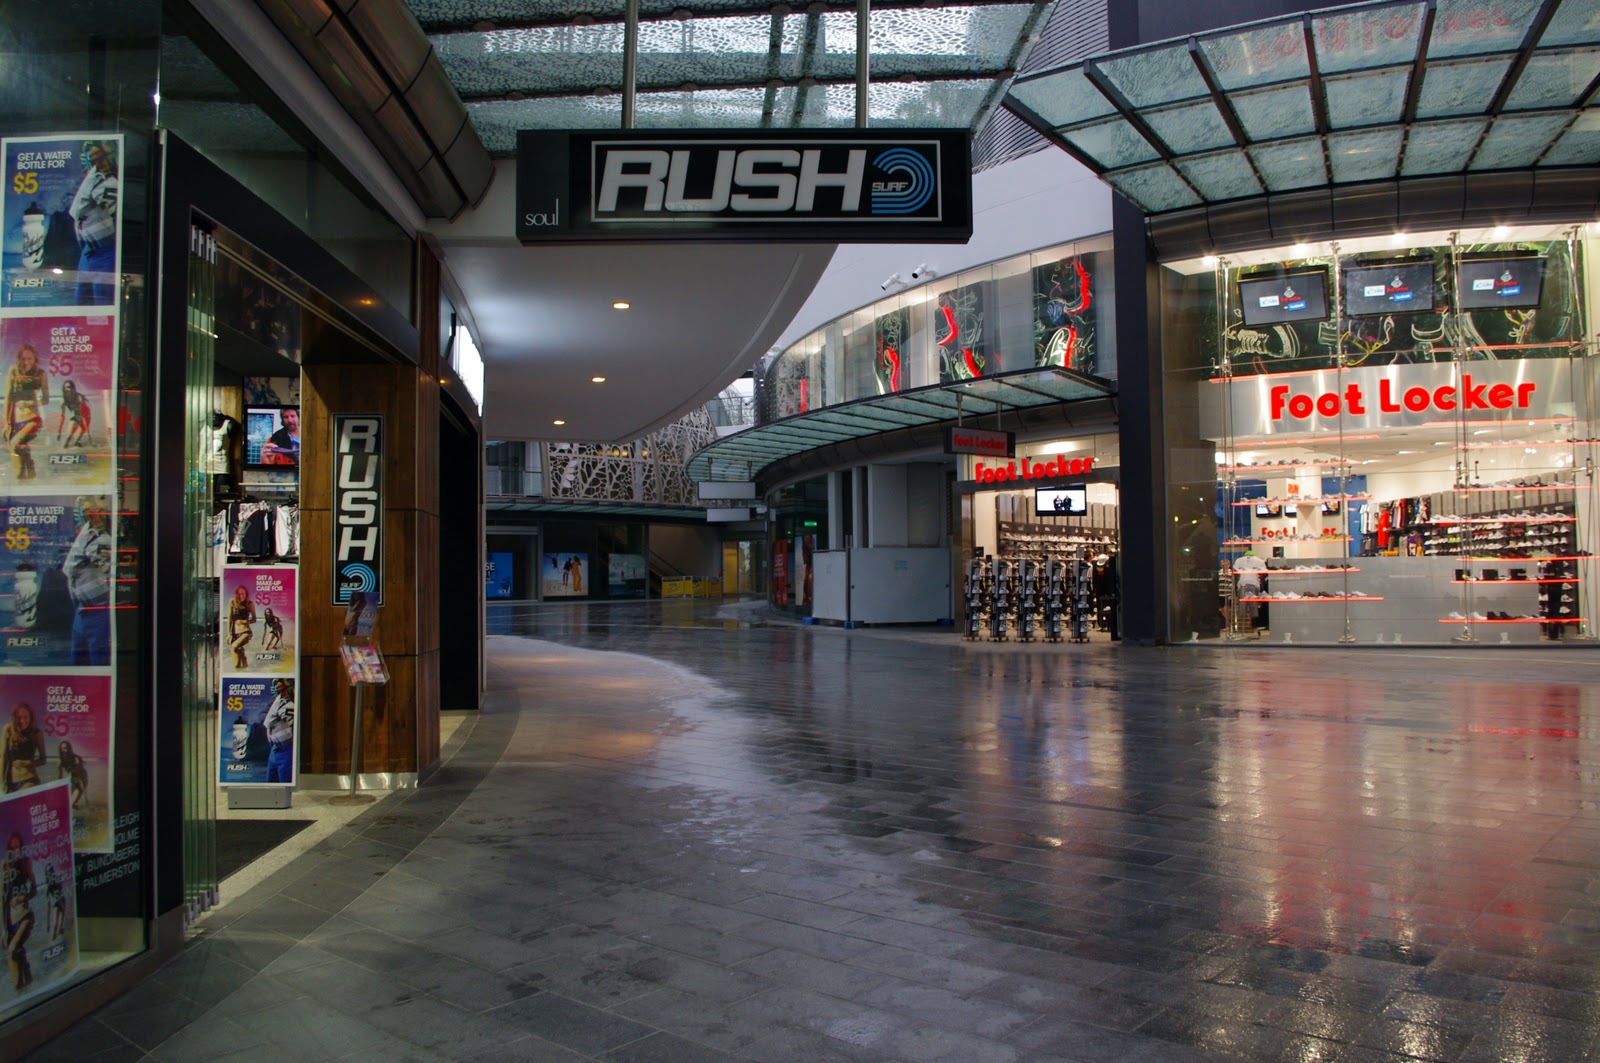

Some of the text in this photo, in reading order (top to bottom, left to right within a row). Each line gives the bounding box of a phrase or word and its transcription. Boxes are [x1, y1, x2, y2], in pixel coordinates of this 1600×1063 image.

[17, 151, 72, 162] GET A WATER
[17, 160, 66, 170] BOTTLE FOR
[13, 172, 38, 195] $5
[597, 149, 867, 212] RUSH
[872, 182, 909, 192] SURF
[525, 198, 559, 226] soul
[14, 279, 44, 288] RUSH
[51, 327, 77, 336] GET A
[51, 336, 90, 344] MAKE-UP
[51, 344, 93, 353] CASE FOR
[49, 354, 74, 376] $5
[1270, 374, 1536, 420] Foot Locker
[953, 433, 1006, 450] Foot Locker
[49, 455, 79, 464] RUSH
[975, 453, 1094, 484] Foot Locker
[338, 419, 379, 561] RUSH
[9, 506, 65, 516] GET A WATER
[9, 514, 58, 525] BOTTLE FOR
[5, 527, 31, 550] $5
[255, 591, 271, 606] $5
[7, 637, 39, 647] RUSH
[48, 686, 73, 695] GET A
[48, 695, 87, 704] MAKE-UP
[227, 697, 243, 712] $5
[47, 704, 89, 713] CASE FOR
[45, 715, 70, 737] $5
[30, 805, 42, 816] GET
[32, 810, 58, 824] MAKE-UP
[32, 823, 49, 836] CASE
[87, 843, 140, 873] BUNDABERG
[83, 860, 140, 891] PALMERSTON
[42, 945, 64, 961] RUSH
